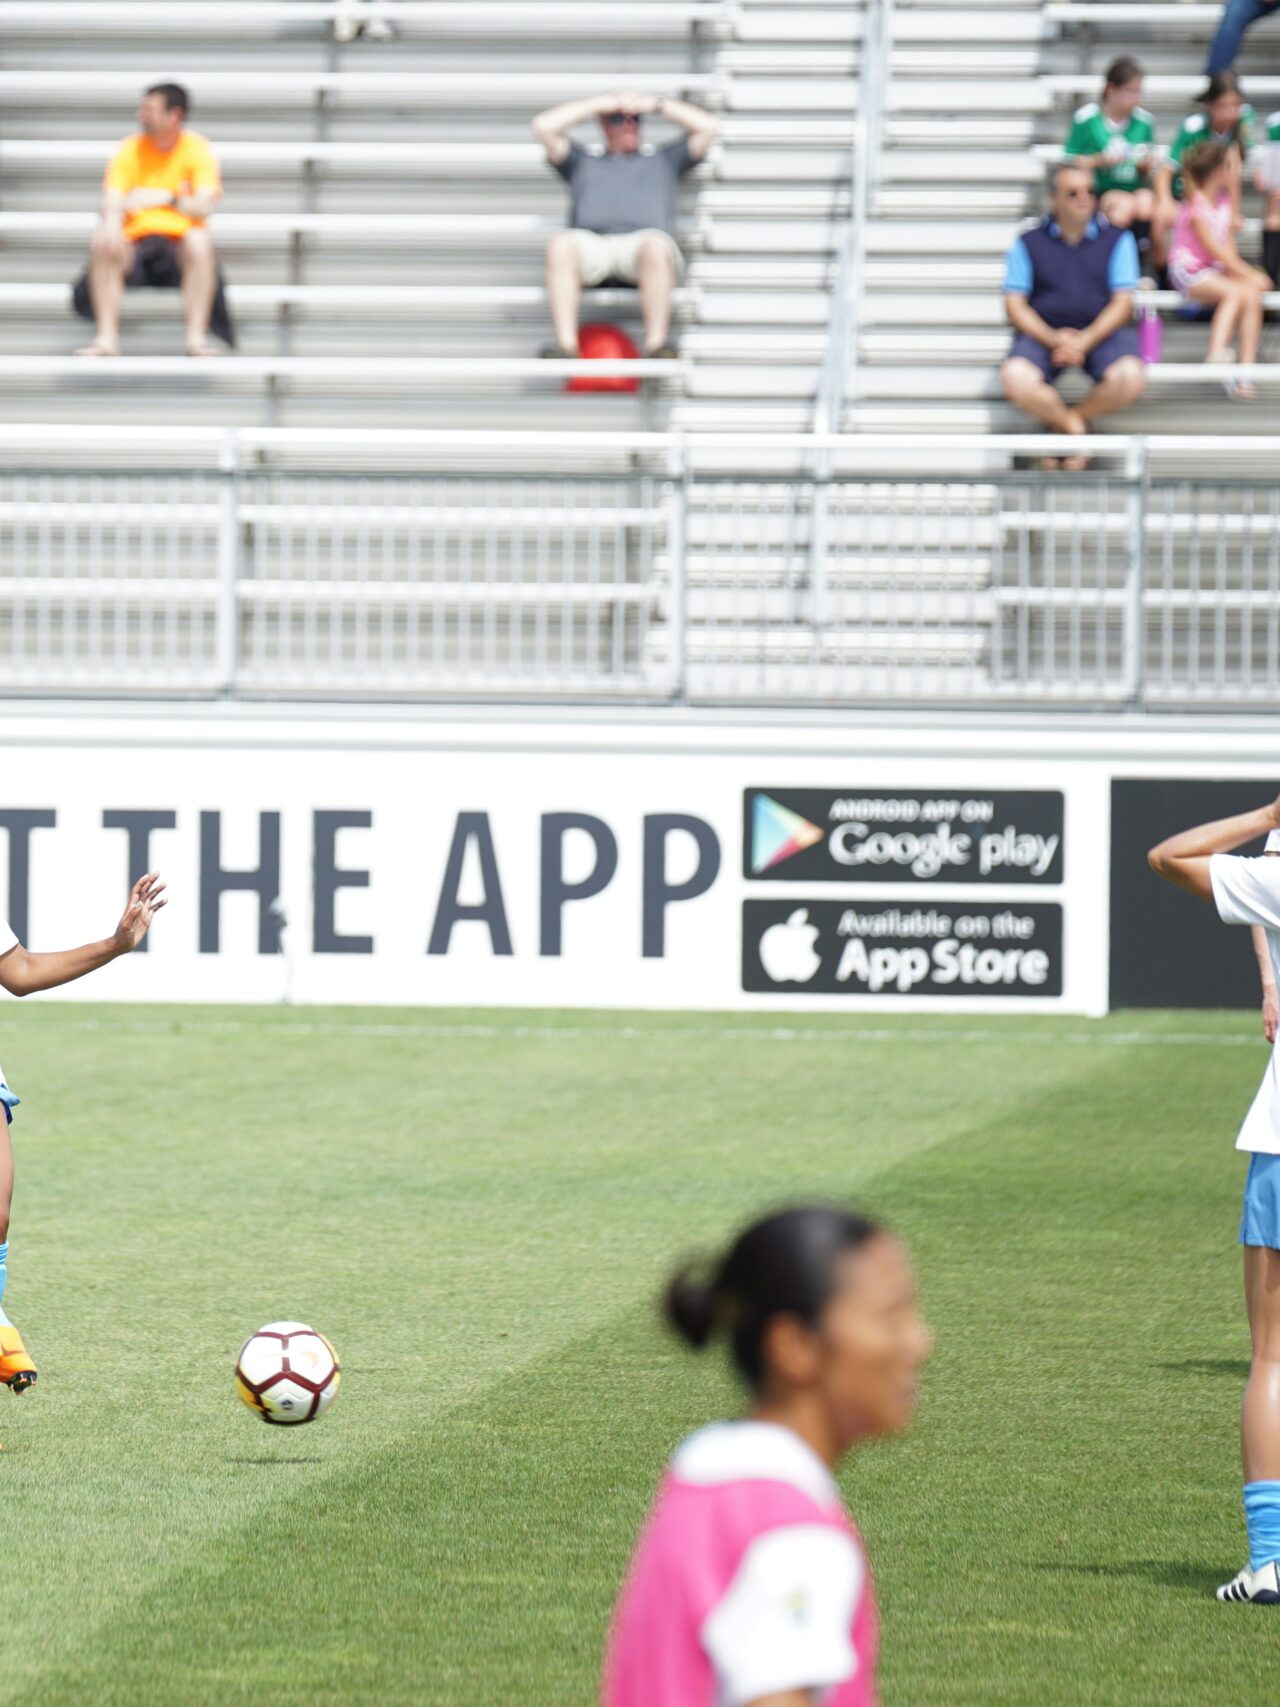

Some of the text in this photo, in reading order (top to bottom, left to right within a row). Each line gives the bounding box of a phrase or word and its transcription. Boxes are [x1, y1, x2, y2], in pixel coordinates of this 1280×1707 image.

[828, 798, 995, 823] ANDROID APP ON
[828, 821, 1060, 878] Google play
[102, 808, 374, 954] THE
[426, 810, 722, 958] APP
[836, 908, 1035, 939] Available on the
[836, 937, 1050, 992] App Store
